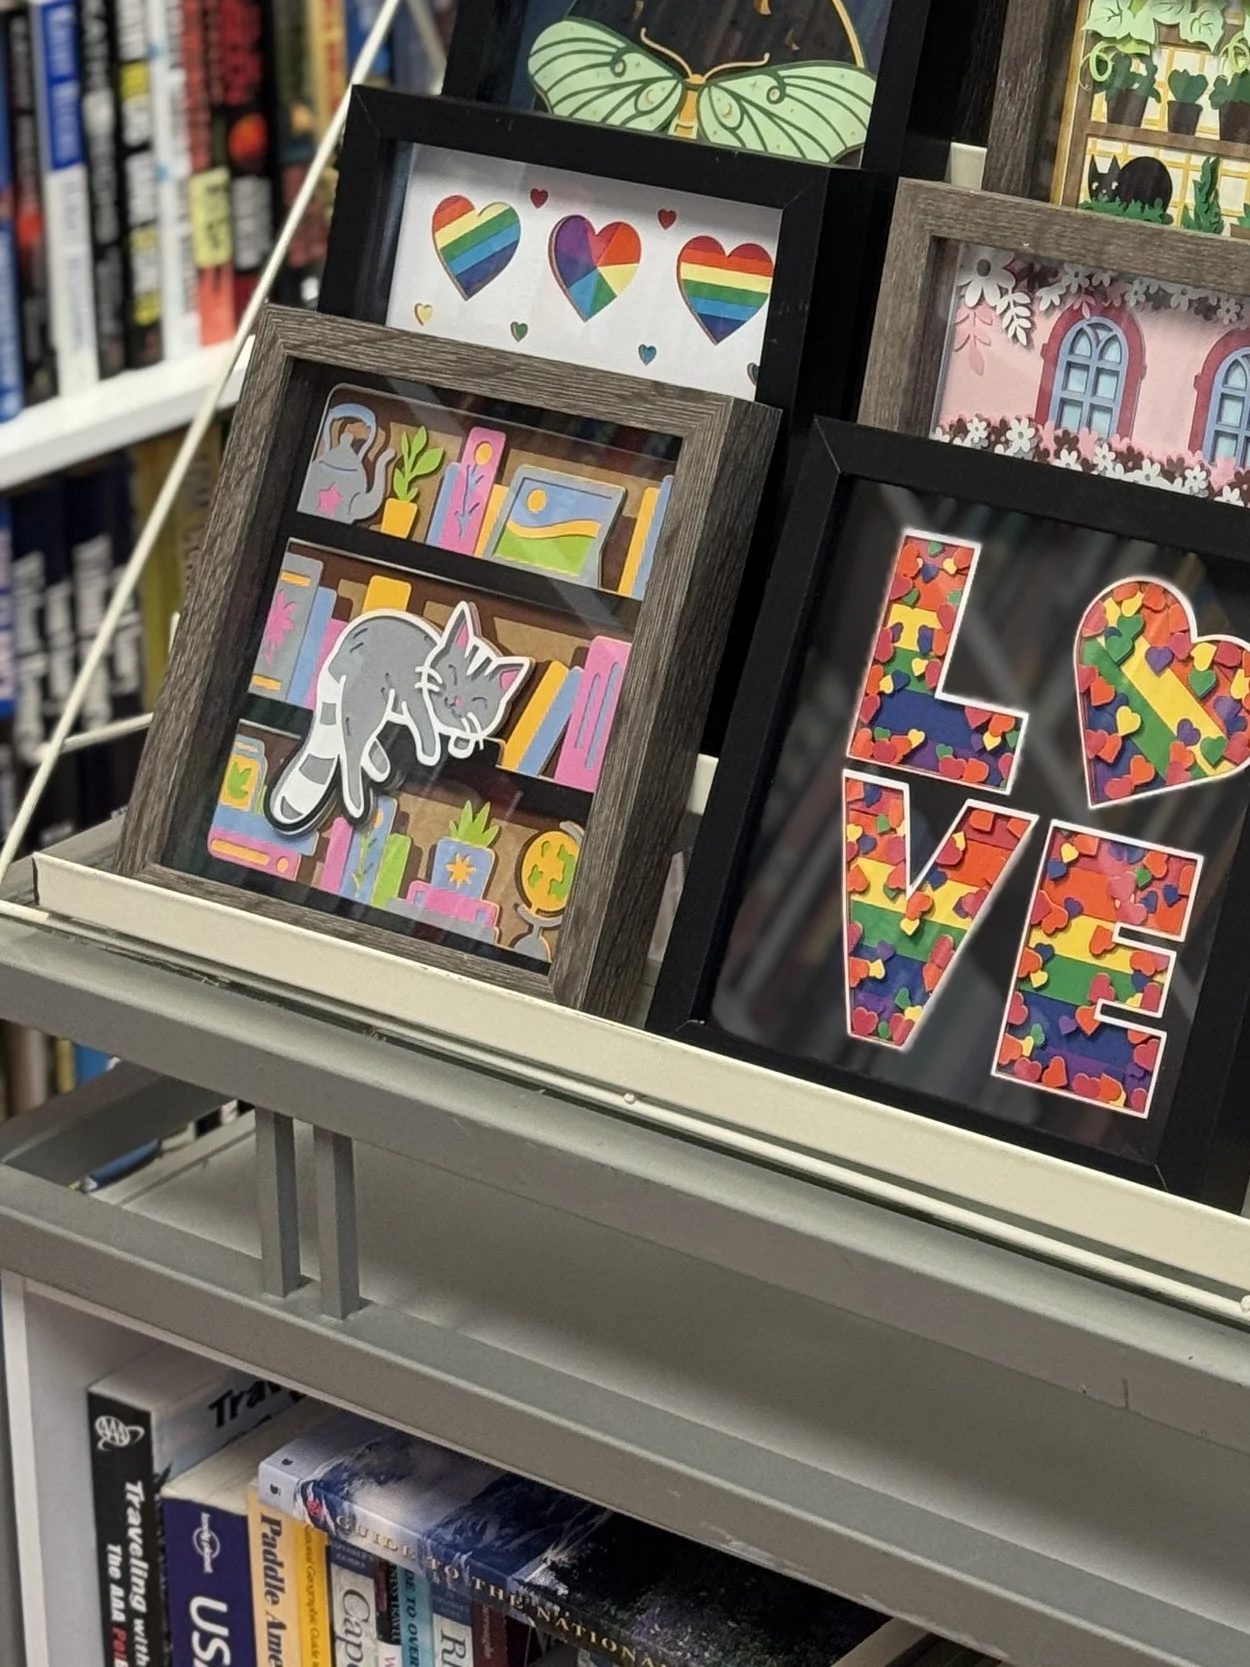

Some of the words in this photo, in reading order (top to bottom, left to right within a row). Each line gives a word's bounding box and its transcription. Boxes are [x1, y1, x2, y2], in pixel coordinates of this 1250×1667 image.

[124, 1481, 149, 1613] Traveling
[200, 1512, 212, 1541] lonely
[106, 1543, 122, 1579] The
[201, 1541, 213, 1574] planet
[261, 1514, 286, 1606] Paddle
[110, 1583, 126, 1623] AAA
[305, 1565, 318, 1623] Geographic
[335, 1513, 417, 1561] GUIDE
[427, 1554, 460, 1581] TO
[470, 1574, 525, 1610] THE
[535, 1603, 667, 1667] NATIONA
[406, 1597, 418, 1618] TO
[134, 1619, 150, 1666] with
[190, 1596, 231, 1667] US
[310, 1627, 321, 1659] Guide
